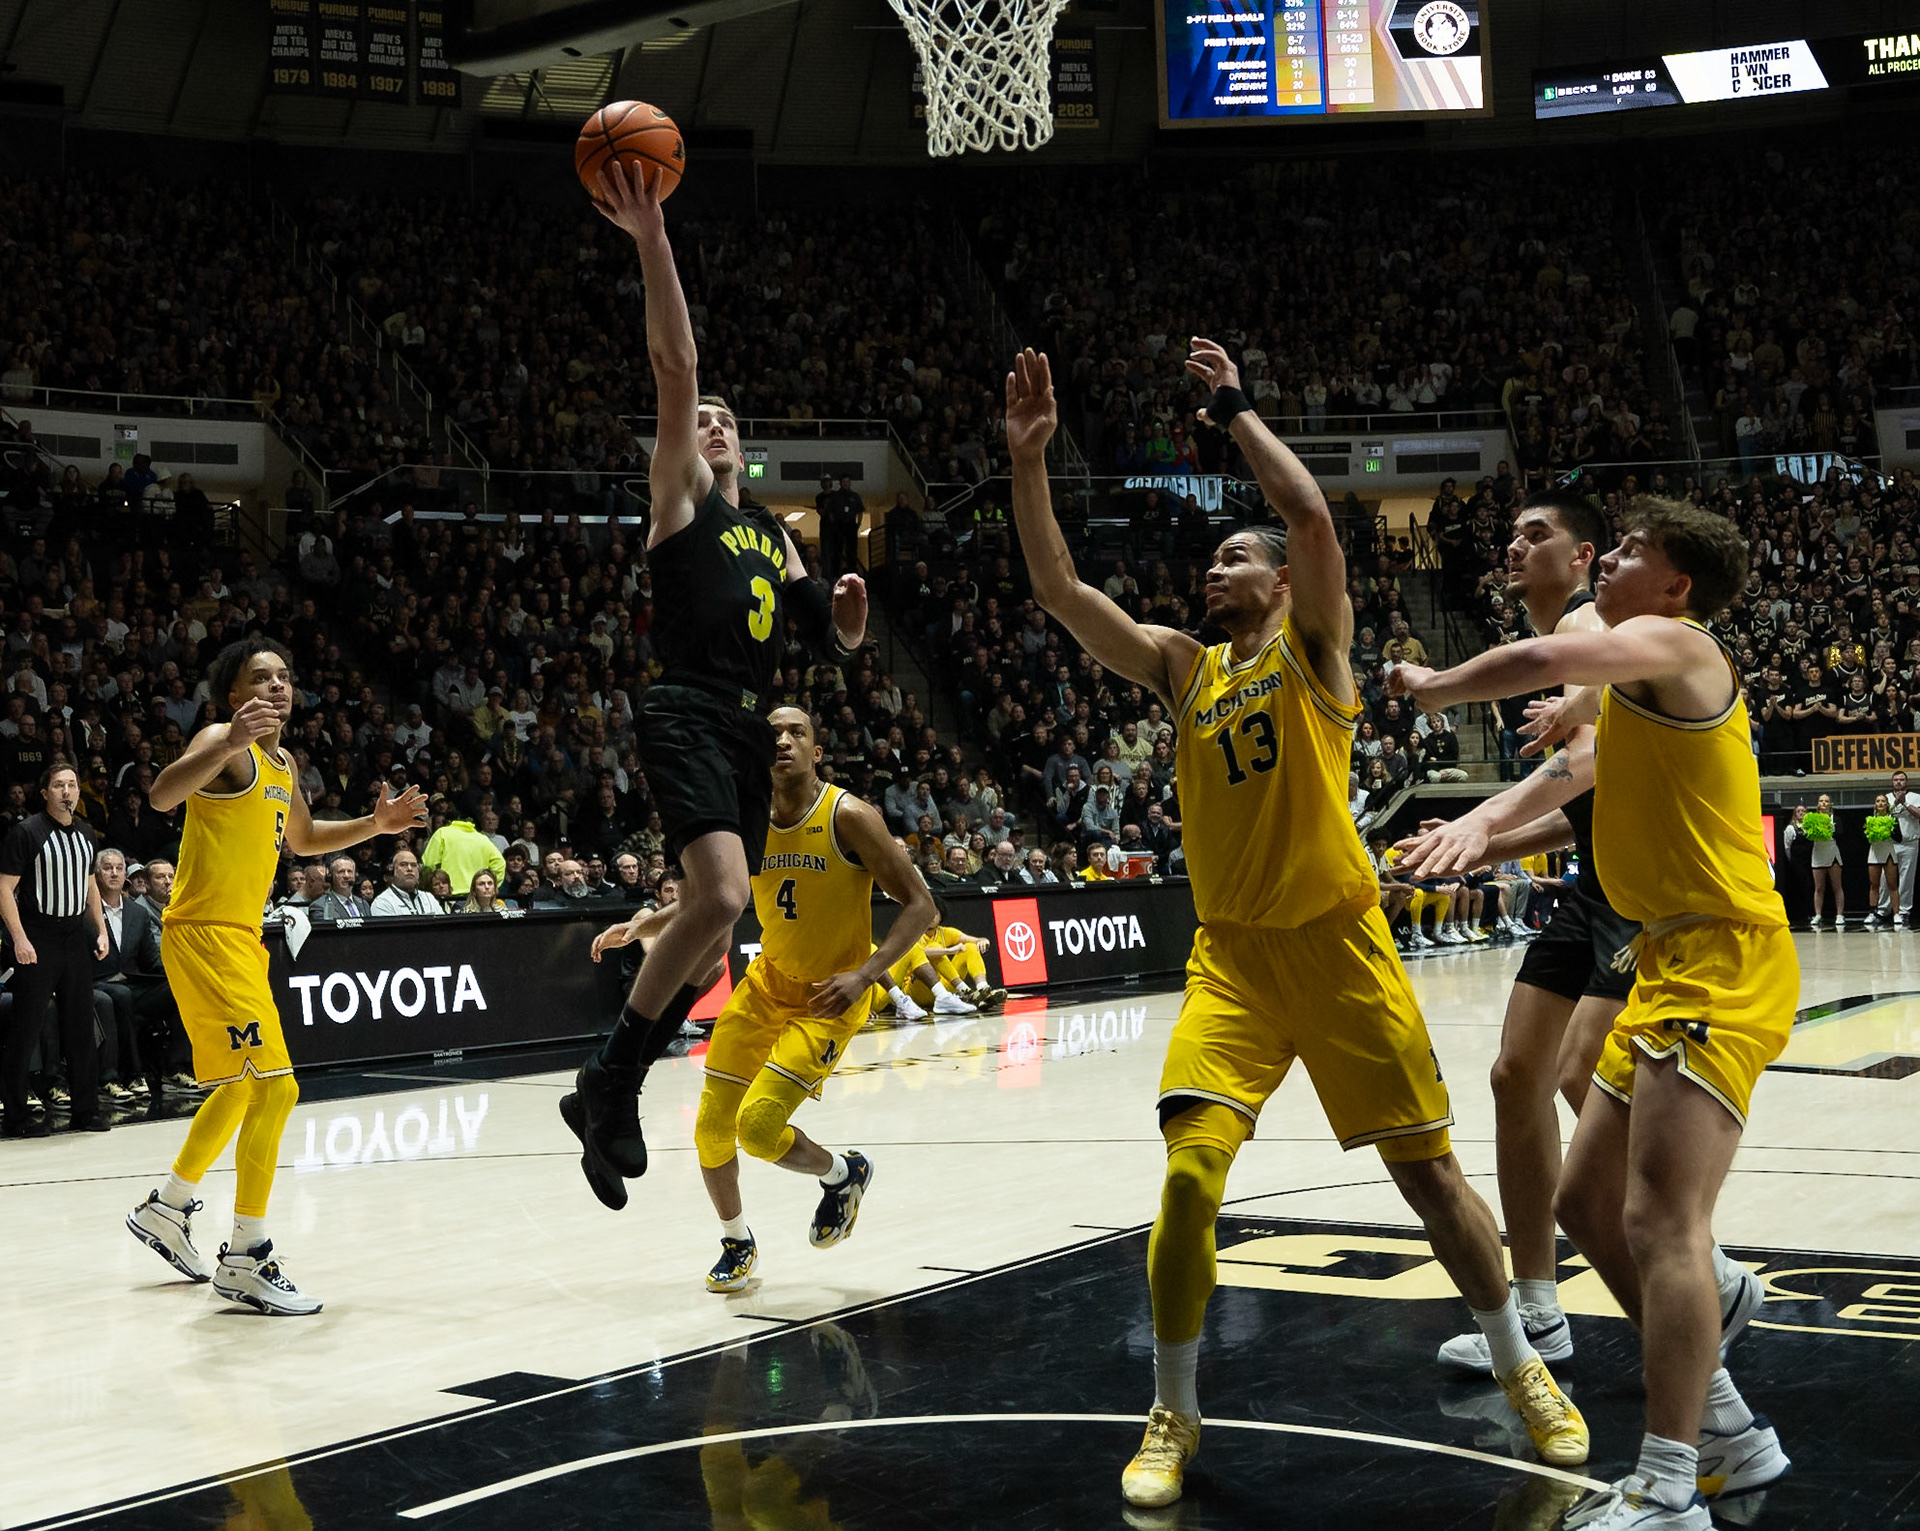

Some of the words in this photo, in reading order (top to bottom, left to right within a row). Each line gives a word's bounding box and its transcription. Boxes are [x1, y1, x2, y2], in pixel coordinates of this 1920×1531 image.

[319, 3, 359, 17] PURDUE
[367, 7, 407, 21] PURDUE
[1418, 4, 1465, 24] UNIVERSITY
[1208, 14, 1233, 23] FIELD
[1234, 13, 1264, 22] GOALS
[276, 25, 304, 35] MEN'S
[325, 29, 353, 40] MEN'S
[273, 36, 288, 46] BIG
[290, 37, 307, 46] TEN
[322, 39, 337, 49] BIG
[340, 41, 356, 51] TEN
[373, 33, 401, 44] MEN'S
[1055, 39, 1093, 50] PURDUE
[1204, 38, 1226, 47] FREE
[1227, 37, 1265, 46] THROWS
[1418, 32, 1438, 51] BOOK
[1442, 31, 1466, 51] STORE
[271, 46, 310, 57] CHAMPS
[370, 43, 384, 53] BIG
[387, 45, 404, 55] TEN
[422, 48, 436, 58] BIG
[320, 50, 358, 62] CHAMPS
[368, 53, 405, 67] CHAMPS
[1731, 47, 1790, 65] HAMMER
[1061, 63, 1088, 72] MEN'S
[1218, 60, 1266, 70] REBOUNDS
[1291, 59, 1303, 69] 31
[1732, 62, 1768, 78] DWN
[1868, 63, 1886, 75] ALL
[1887, 58, 1920, 73] PROCE
[273, 69, 310, 85] 1979
[322, 72, 357, 89] 1984
[1229, 72, 1267, 80] OFFENSIVE
[1612, 70, 1642, 82] DUKE
[370, 75, 403, 93] 1987
[421, 80, 456, 96] 1988
[1057, 83, 1093, 92] CHAMPS
[1229, 82, 1267, 91] DEFENSIVE
[1292, 81, 1303, 89] 20
[1558, 85, 1597, 96] BECK'S
[1613, 84, 1634, 95] LOU
[1733, 74, 1791, 93] CNCER
[1214, 95, 1268, 104] TURNOVERS
[1057, 104, 1094, 117] 2023
[748, 463, 764, 478] EXIT
[1366, 460, 1380, 472] EXIT
[720, 525, 787, 583] PURDUE
[748, 575, 776, 642] 3
[1195, 671, 1282, 728] MCHIGAN
[1217, 710, 1277, 786] 13
[18, 751, 42, 762] 1869
[275, 811, 284, 851] 5
[776, 878, 798, 920] 4
[1048, 915, 1146, 956] TOYOTA
[288, 964, 487, 1026] TOYOTA
[226, 1021, 263, 1051] M
